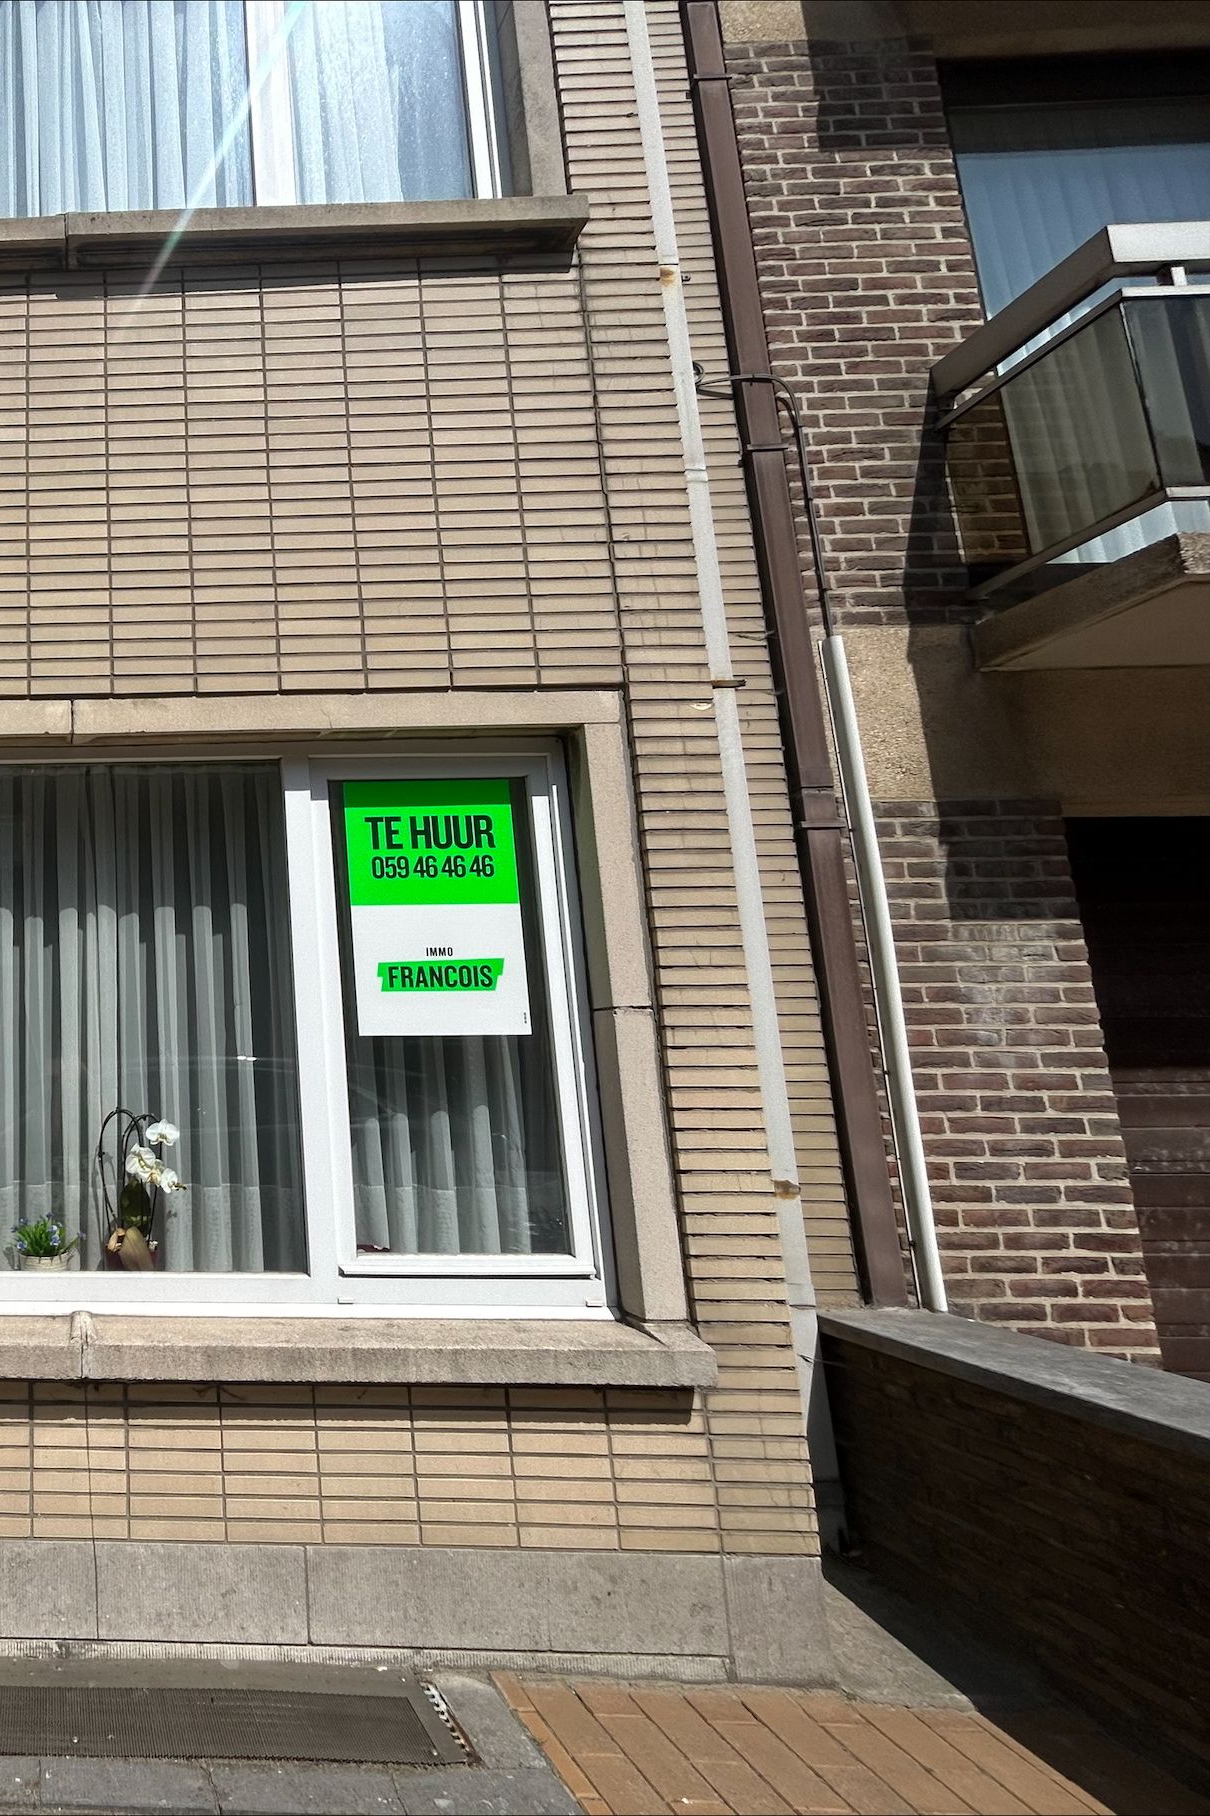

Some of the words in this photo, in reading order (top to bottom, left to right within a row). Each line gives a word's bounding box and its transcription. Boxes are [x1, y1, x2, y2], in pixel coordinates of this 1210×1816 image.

[364, 815, 403, 850] TE
[409, 814, 496, 850] HUUR
[371, 856, 410, 879] 059
[413, 855, 438, 878] 46
[441, 855, 467, 878] 46
[469, 854, 495, 878] 46
[426, 947, 453, 957] IMMO
[388, 965, 493, 988] FRANCOIS
